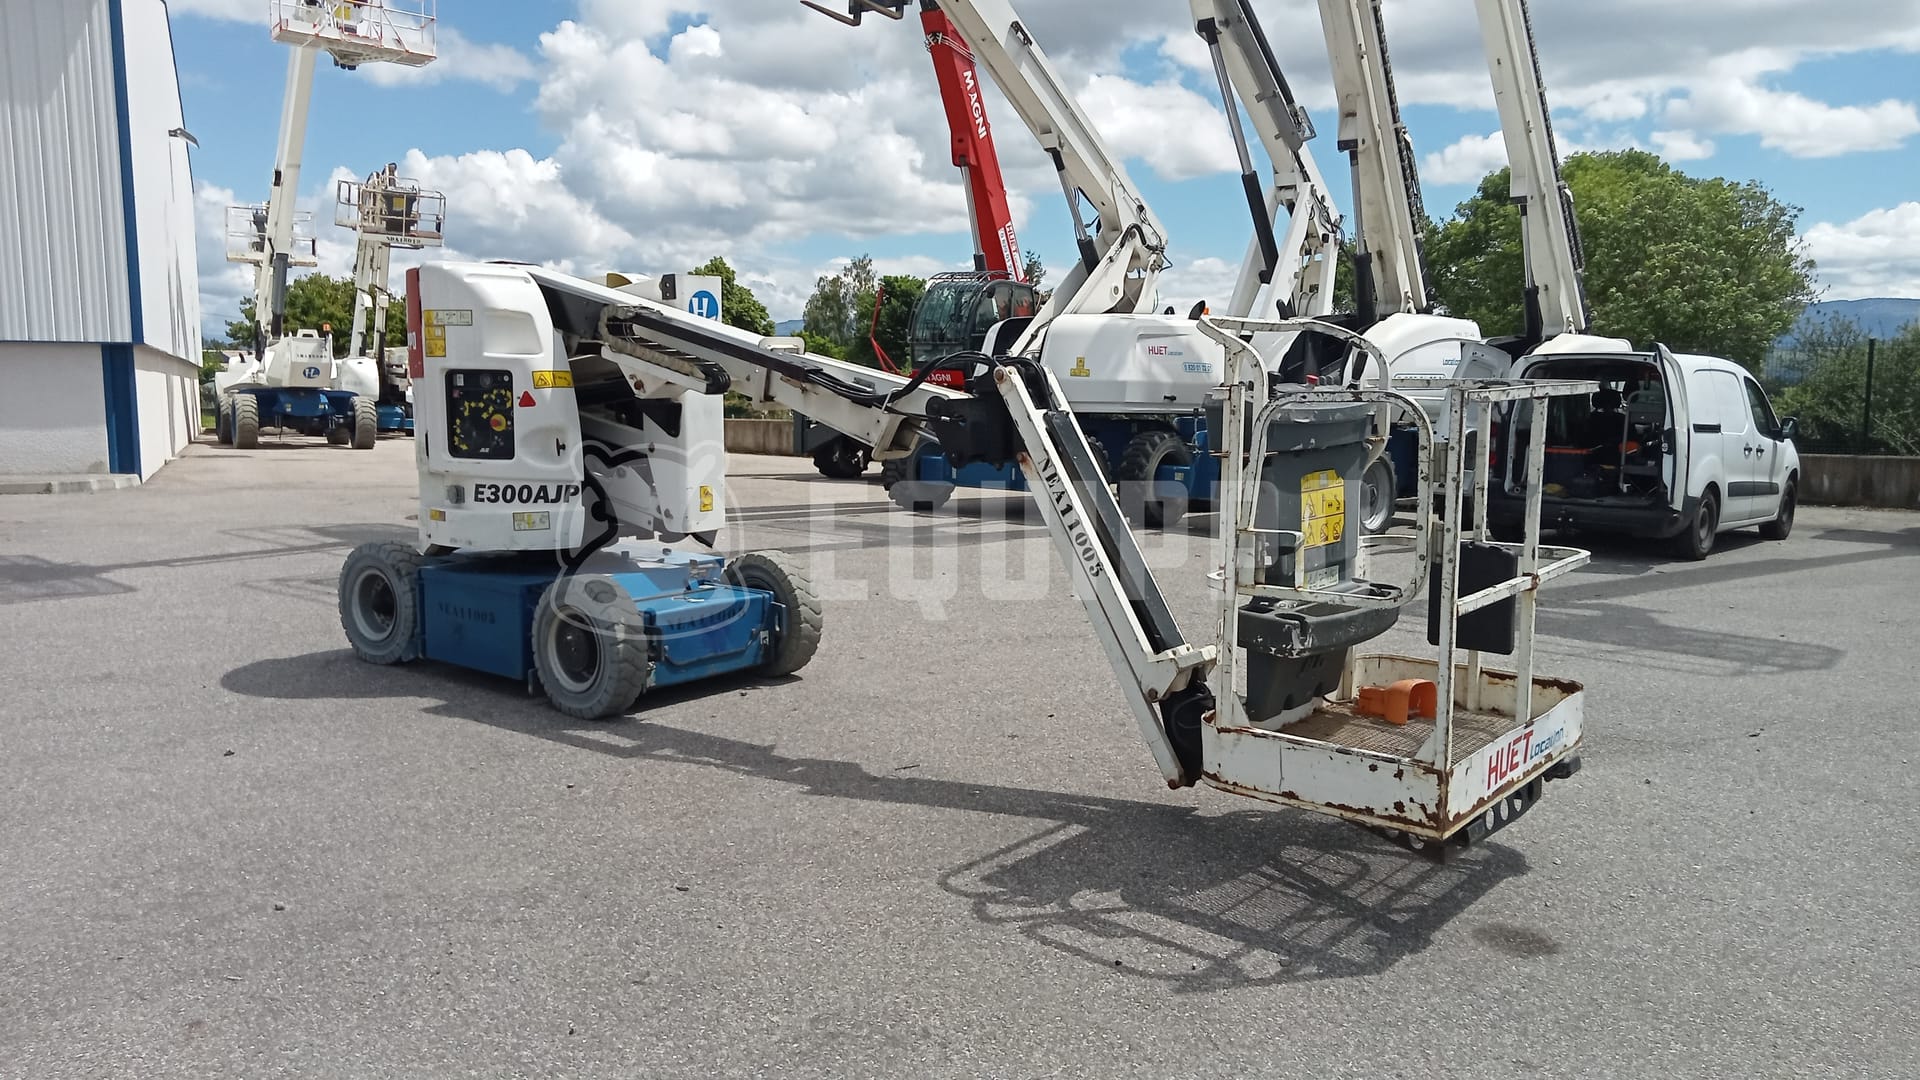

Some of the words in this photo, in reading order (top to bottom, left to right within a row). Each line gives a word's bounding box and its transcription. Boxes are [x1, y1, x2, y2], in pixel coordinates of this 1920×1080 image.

[963, 70, 987, 139] MAGNI
[1148, 345, 1168, 356] HUET
[474, 483, 580, 504] E300AJP
[1038, 455, 1105, 577] NEA11005
[1487, 729, 1534, 791] HUET
